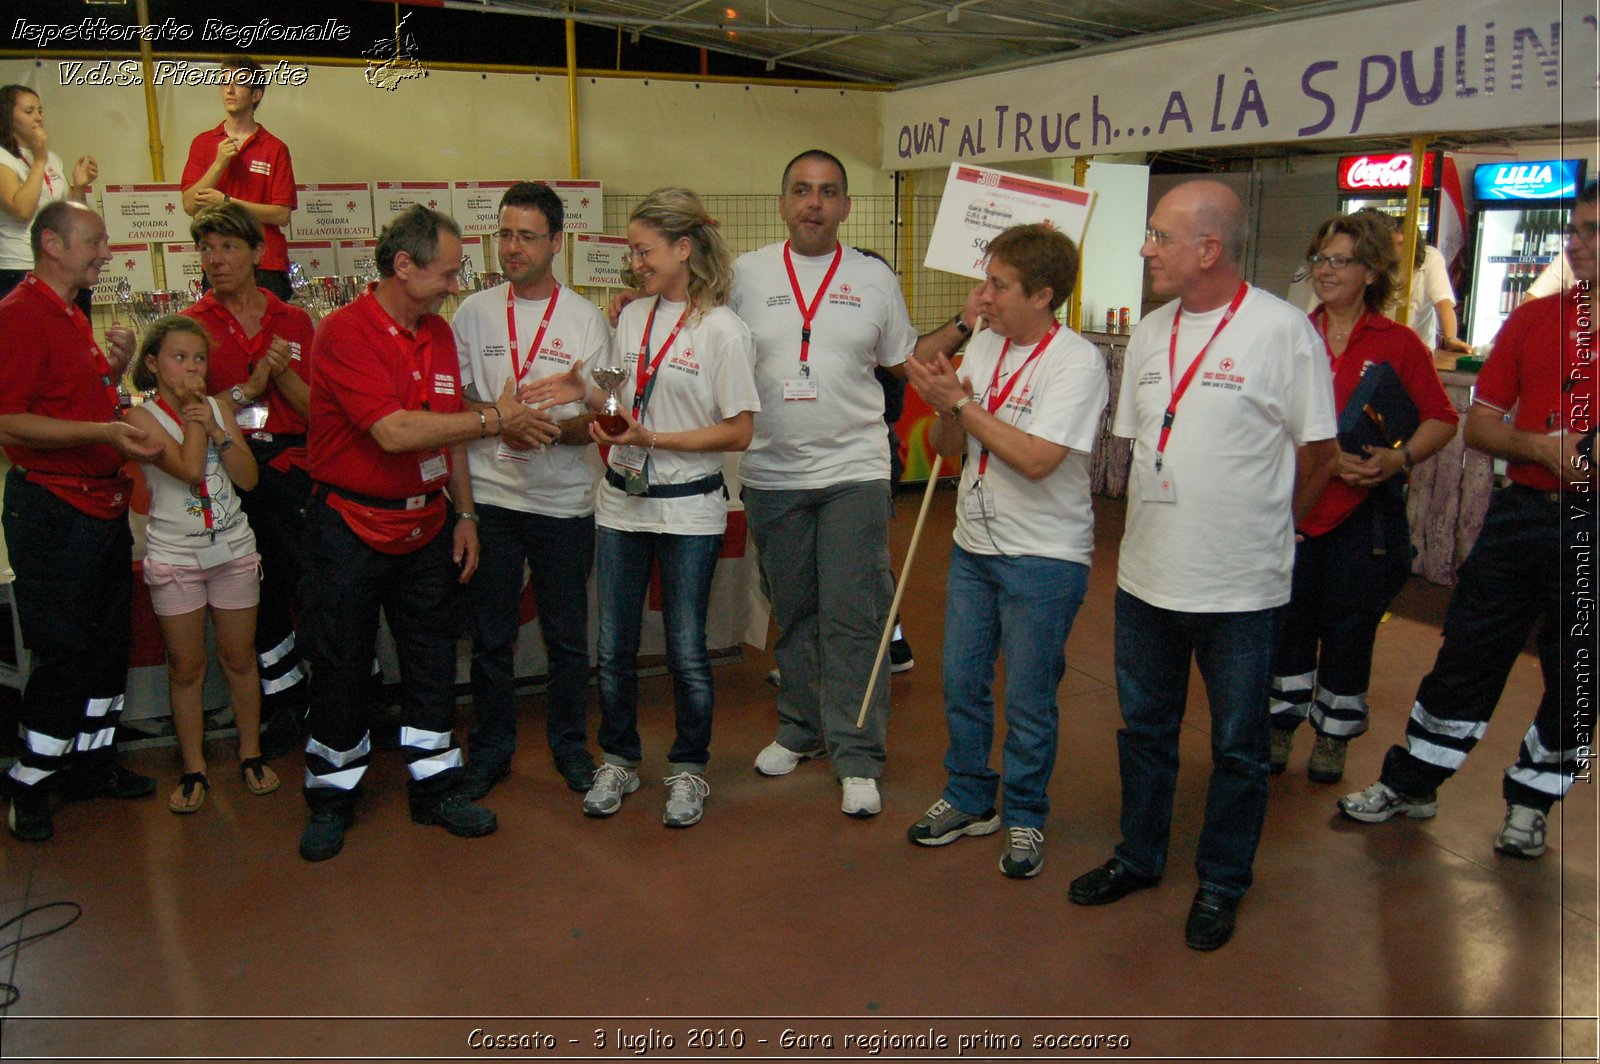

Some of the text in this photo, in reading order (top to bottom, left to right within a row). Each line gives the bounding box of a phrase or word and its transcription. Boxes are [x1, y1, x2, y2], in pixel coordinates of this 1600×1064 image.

[898, 117, 950, 159] QUAT
[1494, 165, 1552, 185] LILIA
[132, 220, 168, 229] SQUADRA
[316, 218, 349, 226] SQUADRA
[128, 230, 175, 239] CANNOBIO
[296, 227, 342, 236] VILLANOVA
